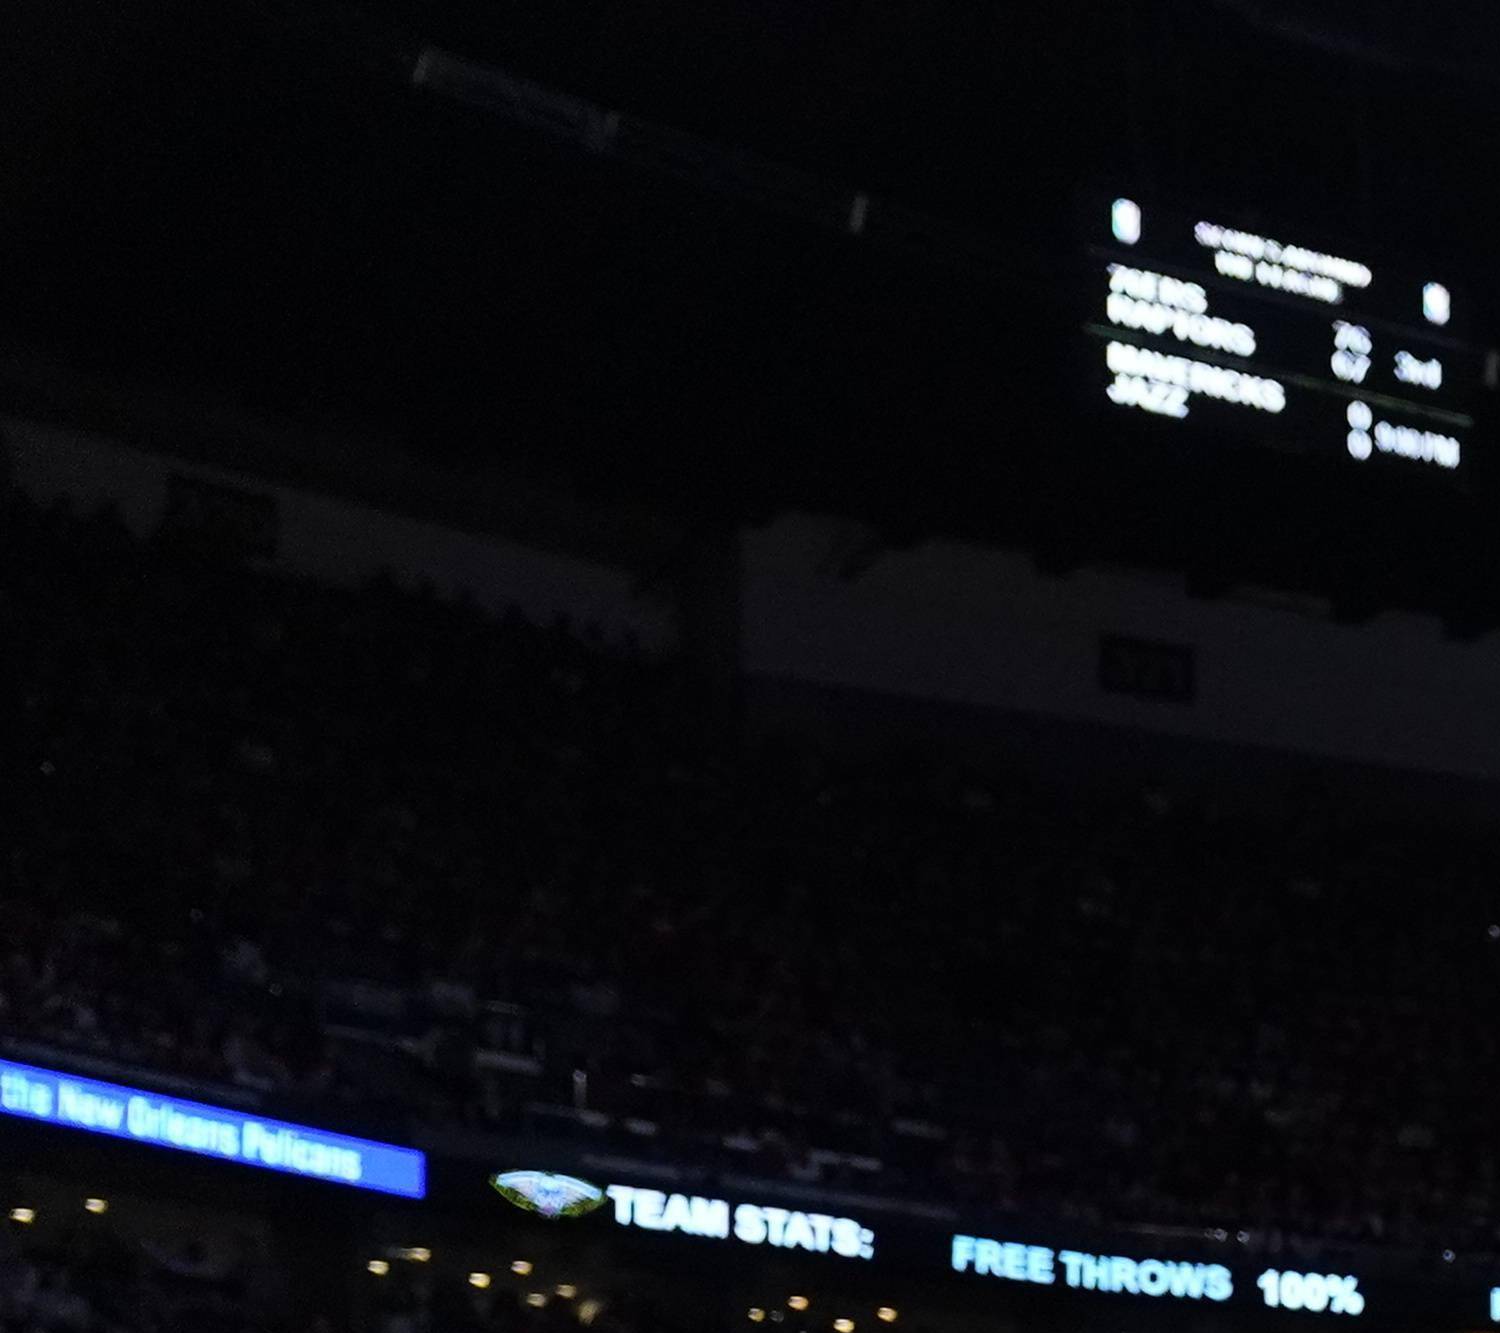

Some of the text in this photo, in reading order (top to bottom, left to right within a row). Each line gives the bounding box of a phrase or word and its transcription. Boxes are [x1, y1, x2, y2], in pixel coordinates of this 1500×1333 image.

[127, 1096, 238, 1156] Orleans
[242, 1122, 362, 1181] Pelicans
[609, 1185, 873, 1258] TEAM STATS:
[952, 1234, 1364, 1315] FREE THROWS 100%
